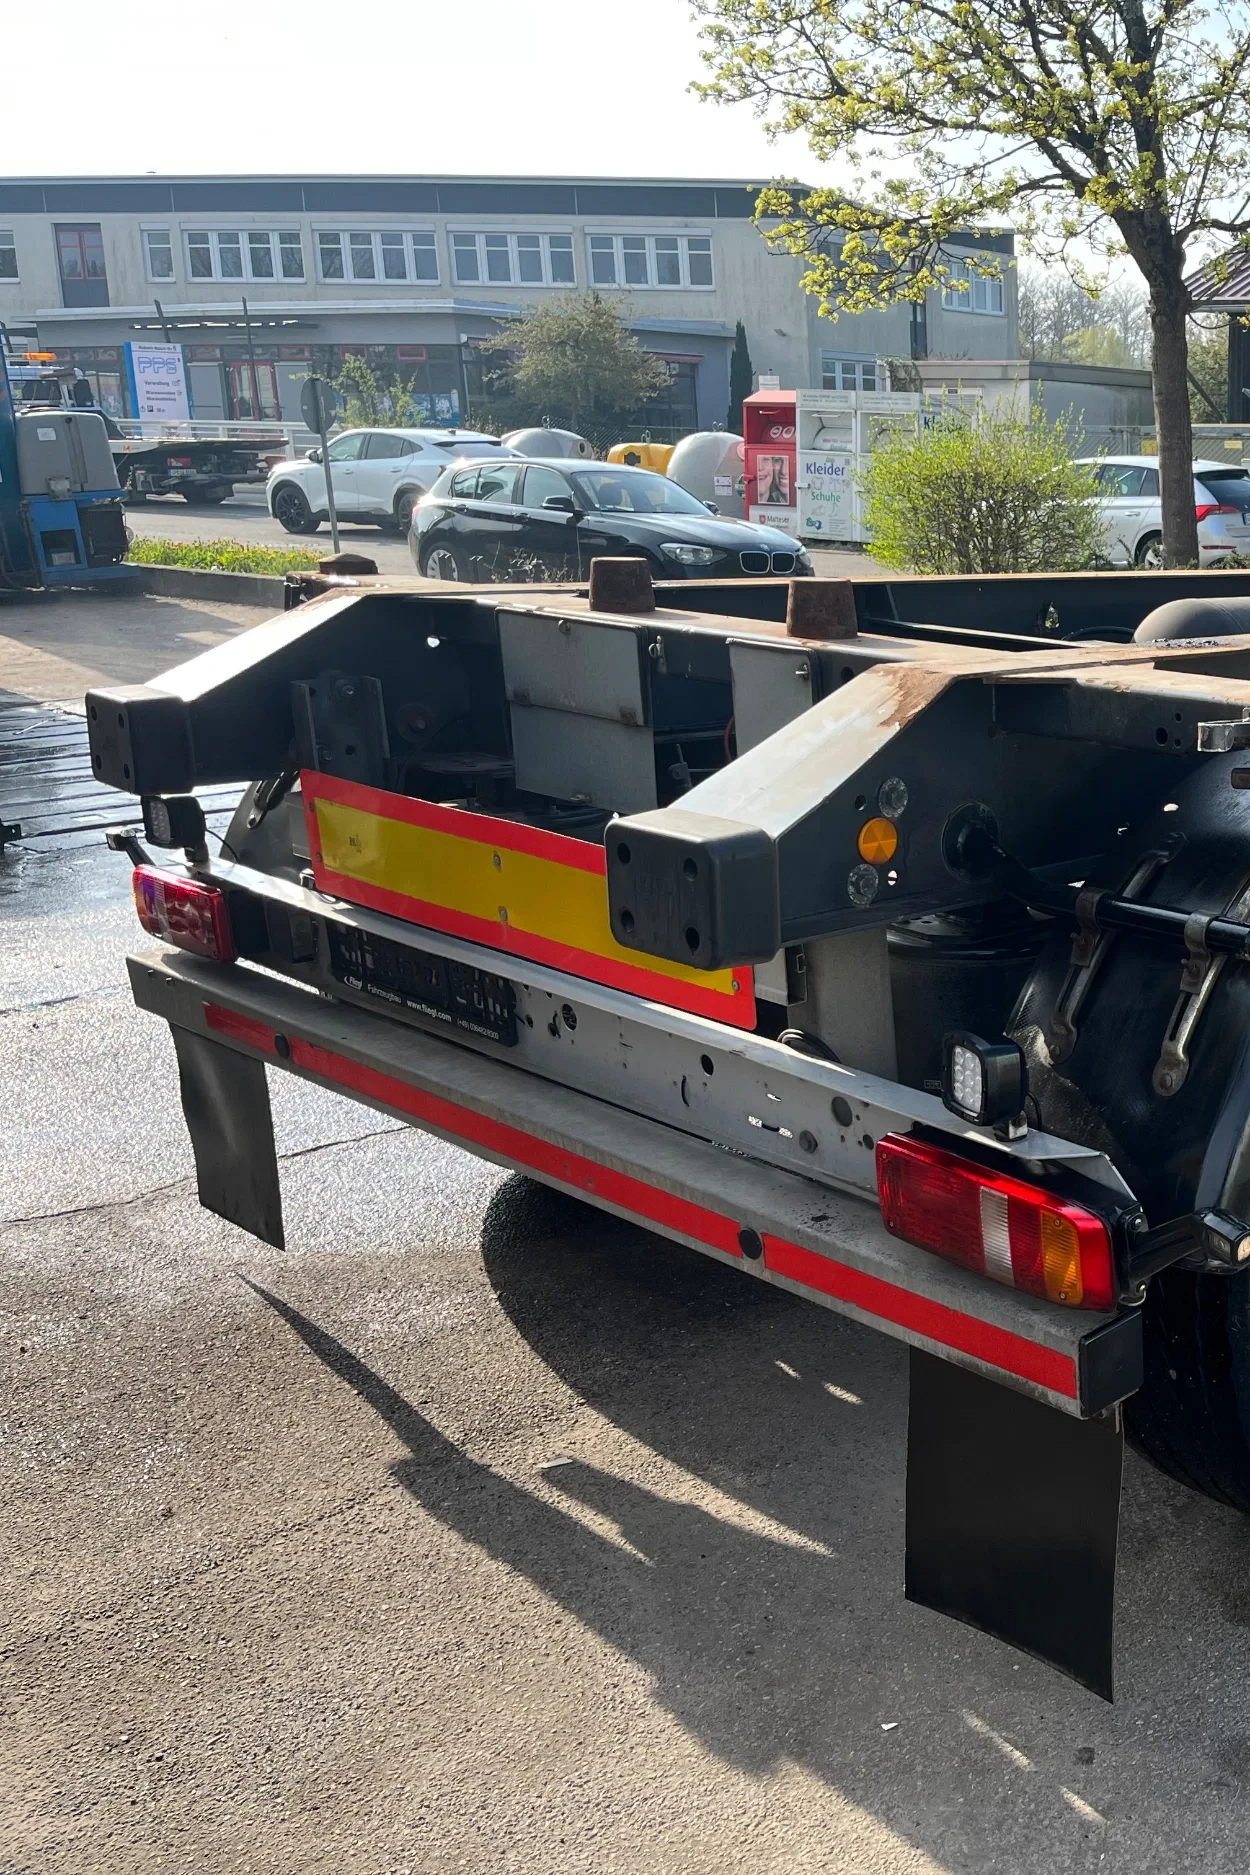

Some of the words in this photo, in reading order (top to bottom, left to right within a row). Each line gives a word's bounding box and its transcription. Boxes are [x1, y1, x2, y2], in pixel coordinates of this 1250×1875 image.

[138, 357, 177, 374] PPS
[806, 462, 846, 476] Kleider
[811, 491, 841, 503] Schuhe
[367, 983, 402, 1004] Fahrzeugbau
[406, 999, 452, 1023] www.fliegl.com
